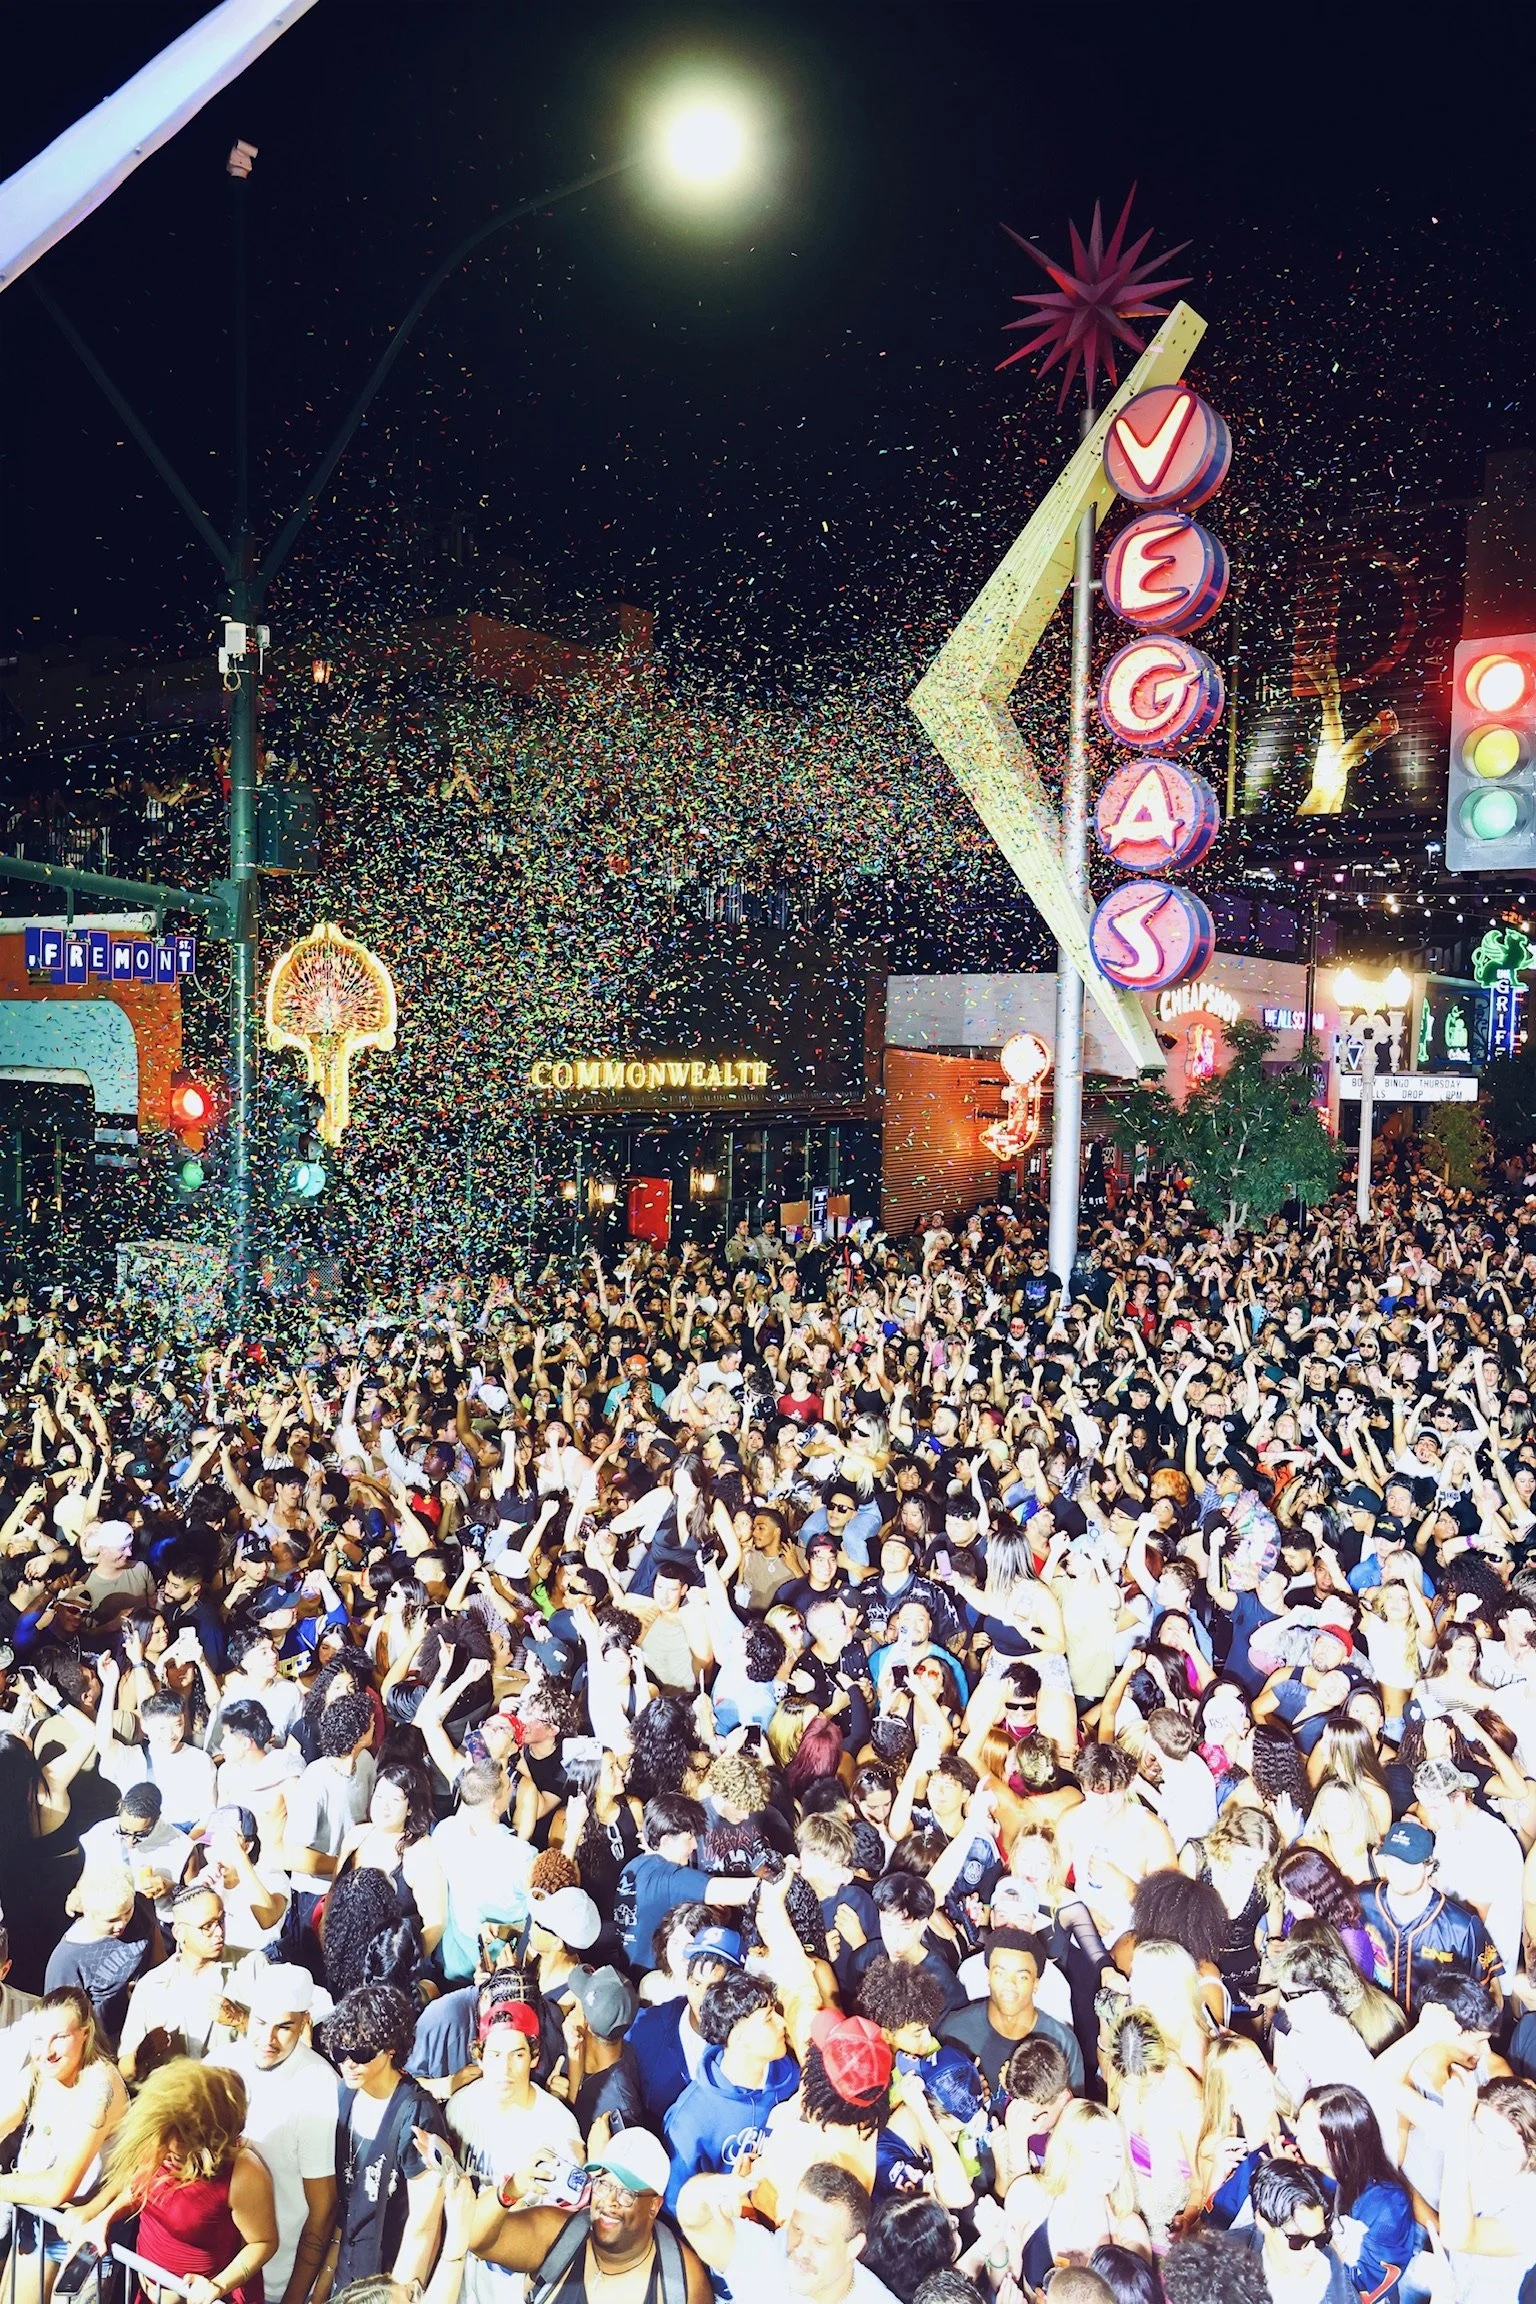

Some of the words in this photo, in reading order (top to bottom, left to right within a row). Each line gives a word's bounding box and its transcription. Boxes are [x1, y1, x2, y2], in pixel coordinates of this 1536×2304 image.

[1103, 393, 1204, 979] VEGAS
[44, 943, 192, 972] FREMONT
[178, 939, 192, 950] ST.
[1159, 982, 1242, 1027] CHEAPSHOT
[530, 1060, 770, 1090] COMMONWEALTH
[1385, 1078, 1410, 1088] BINGO
[1419, 1078, 1462, 1089] THURSDAY
[1401, 1089, 1424, 1099] DROP
[95, 1945, 131, 1981] MORE
